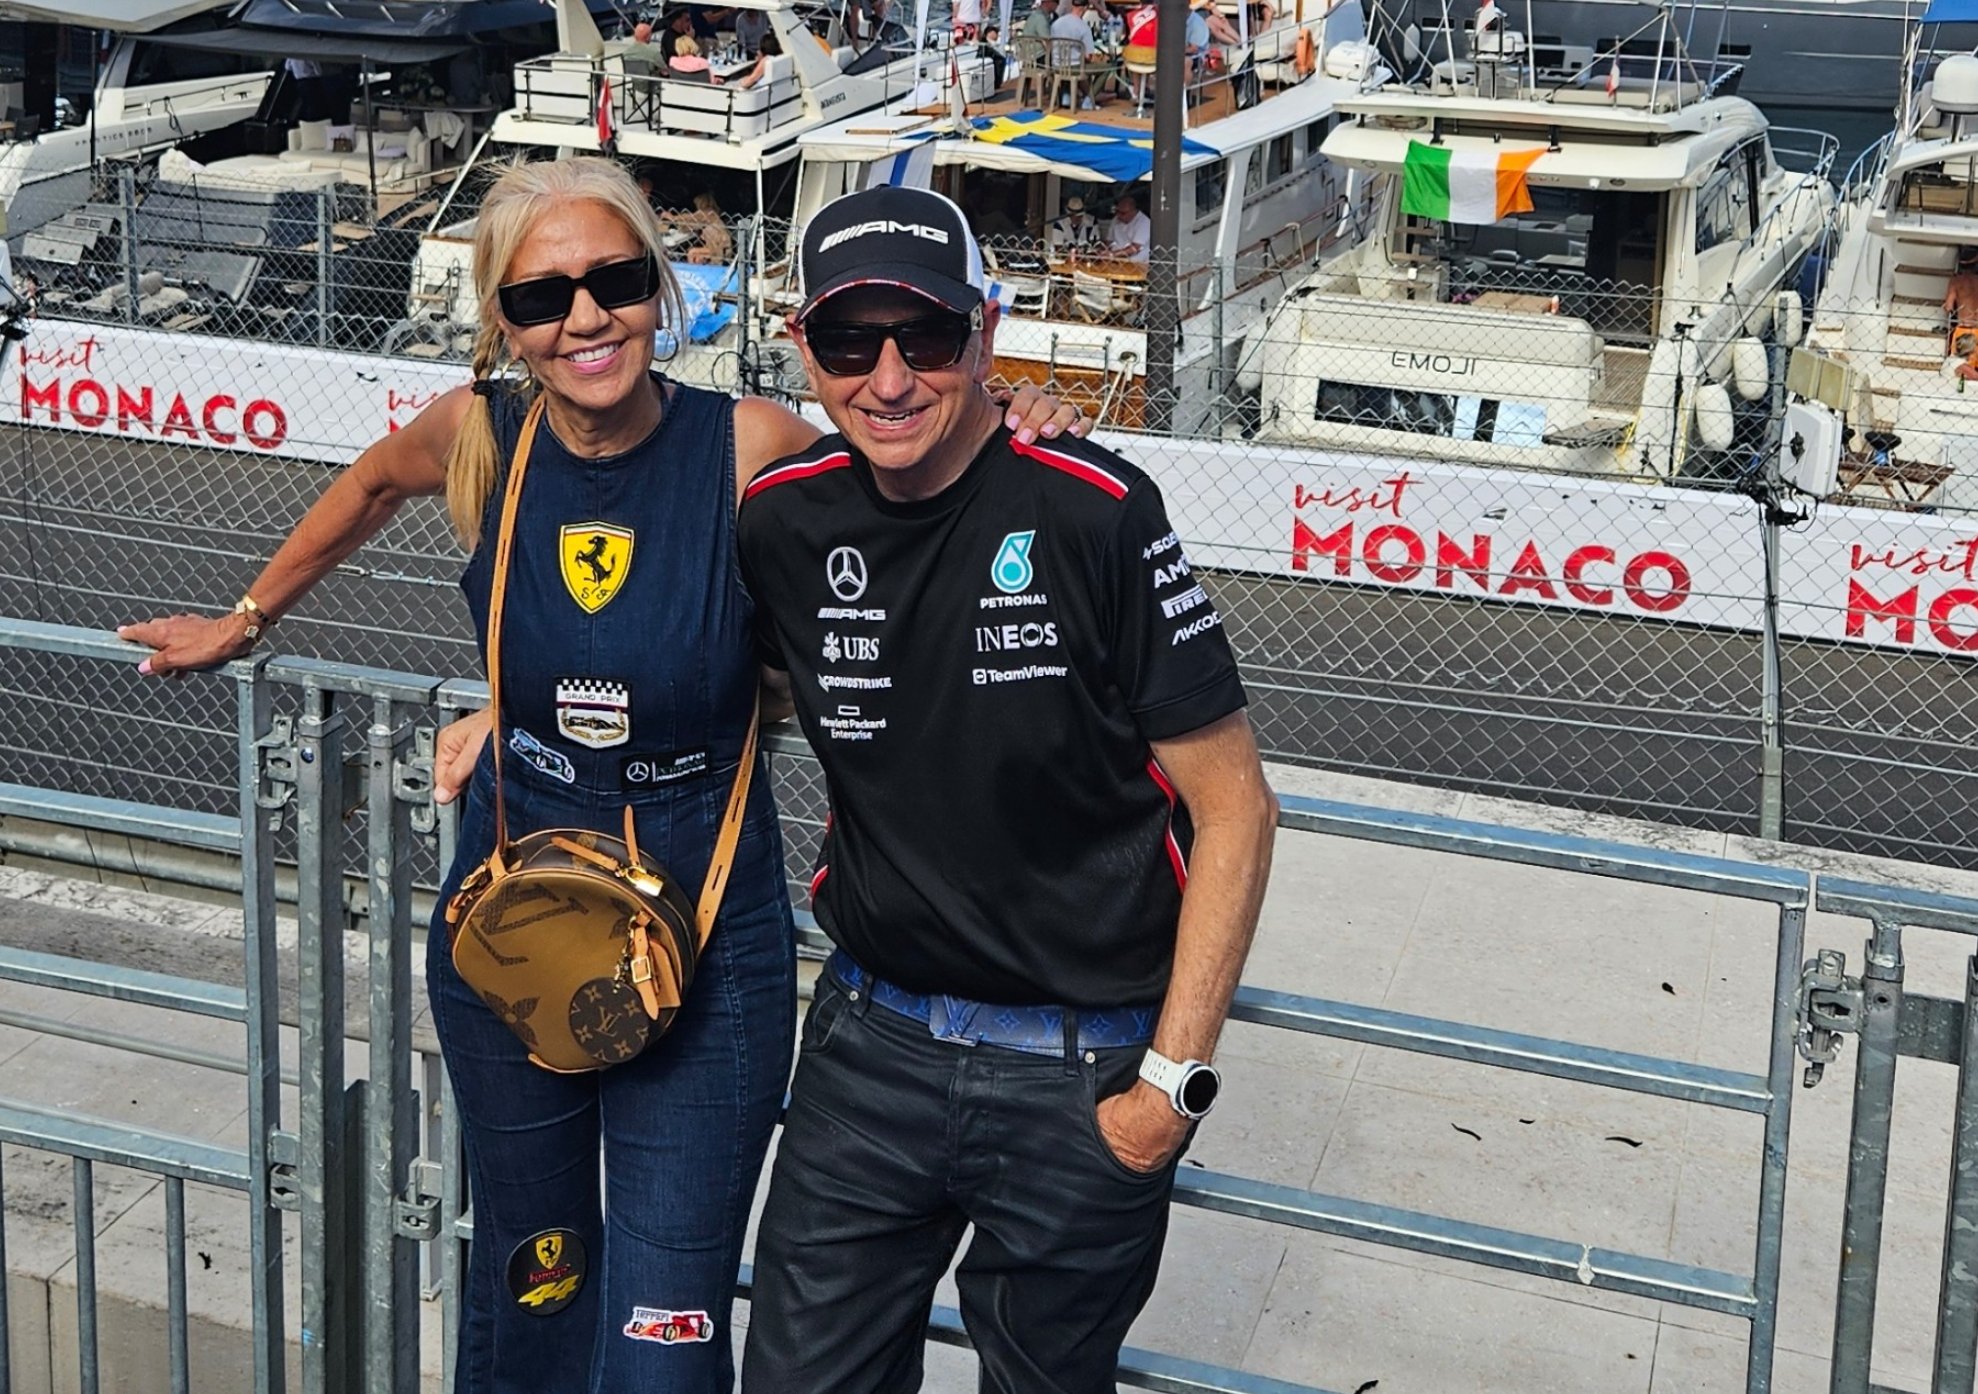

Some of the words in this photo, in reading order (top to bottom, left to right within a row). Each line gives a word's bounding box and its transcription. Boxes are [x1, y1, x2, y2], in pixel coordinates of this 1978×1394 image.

[20, 334, 103, 374] visit
[1391, 351, 1476, 376] EMOJI
[21, 374, 288, 449] MONACO
[1293, 471, 1424, 518] visit
[1291, 515, 1692, 612] MONACO
[979, 594, 1048, 609] PETRONAS
[842, 636, 880, 661] UBS
[975, 622, 1059, 652] INEOS
[823, 675, 893, 689] CROWDSTRIKE
[987, 665, 1068, 682] TeamViewer
[564, 692, 596, 701] GRAND
[820, 715, 849, 729] Hewlett
[849, 718, 887, 729] Packard
[830, 728, 873, 741] Enterprise
